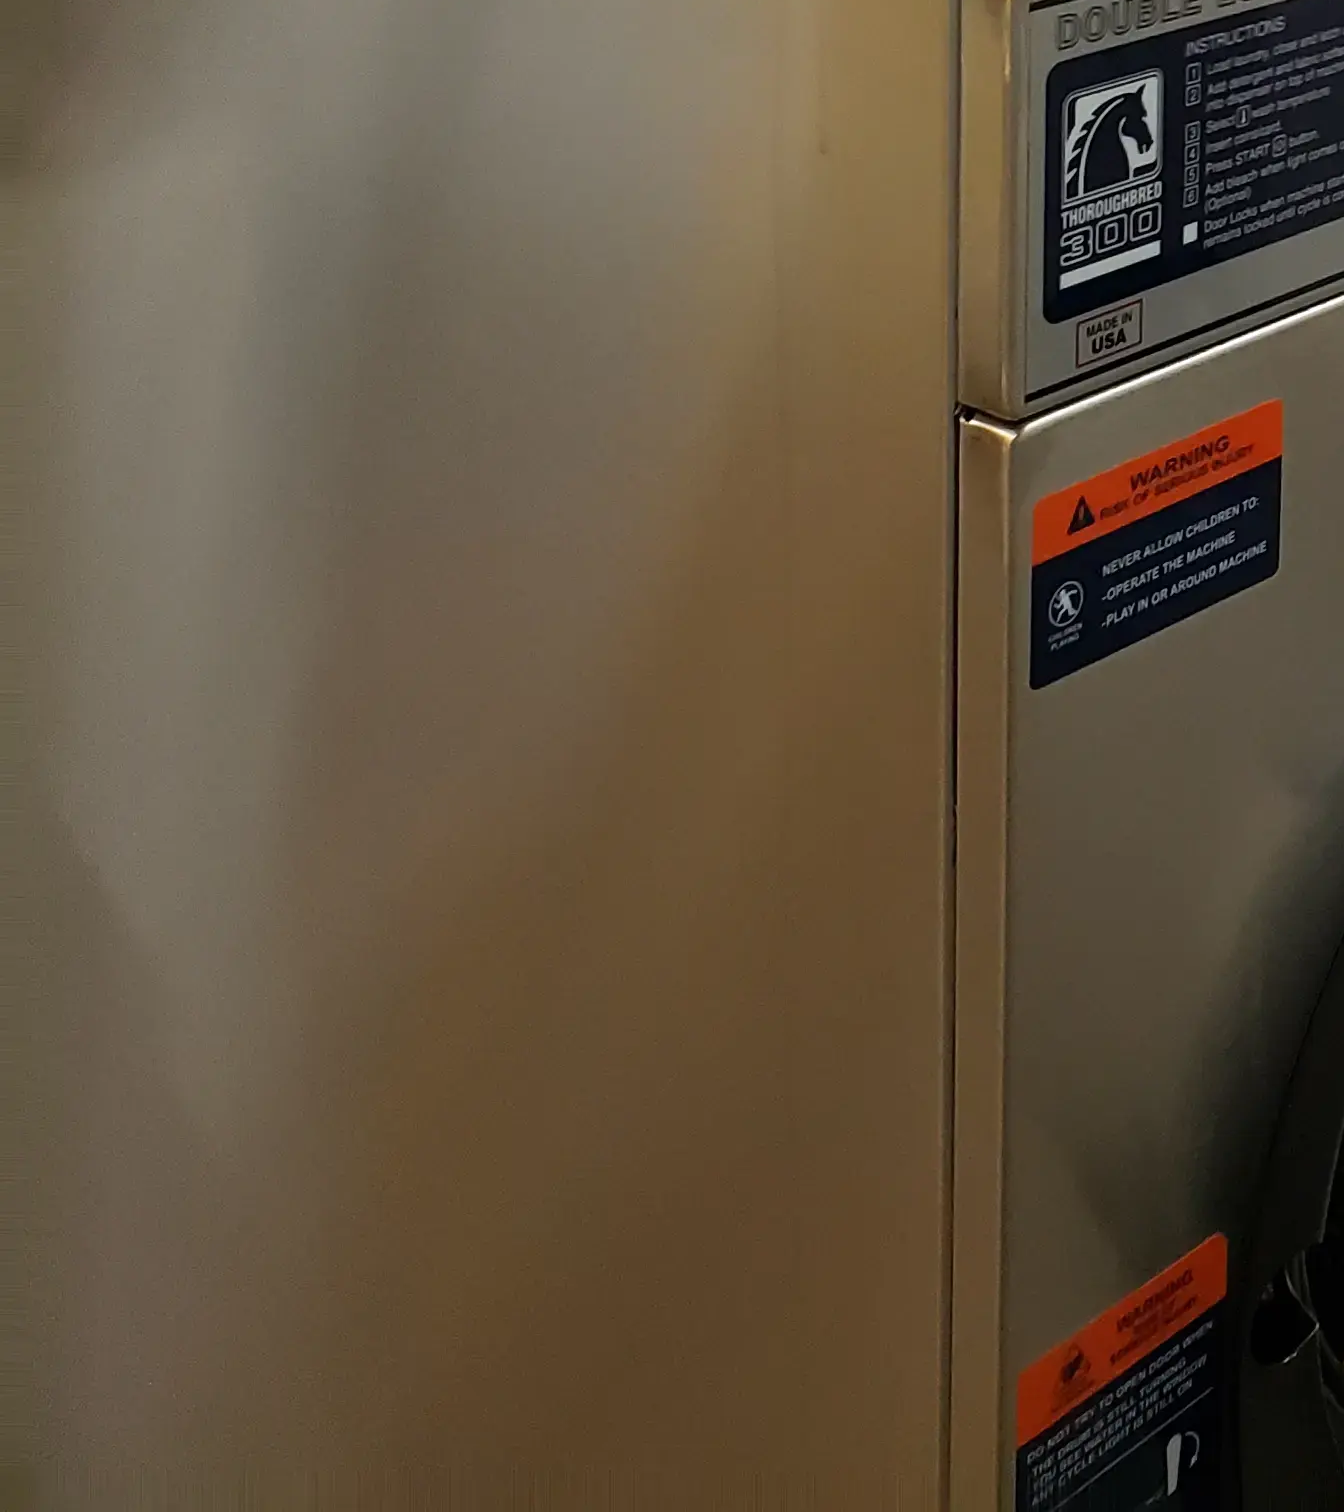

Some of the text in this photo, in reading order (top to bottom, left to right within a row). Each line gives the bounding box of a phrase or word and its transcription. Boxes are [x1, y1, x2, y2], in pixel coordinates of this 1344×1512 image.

[1185, 15, 1287, 58] INSTRUCTIONS
[1235, 143, 1271, 166] START
[1061, 181, 1163, 230] THOROUGHBRED
[1204, 216, 1228, 234] Door
[1060, 202, 1163, 267] 300
[1086, 309, 1133, 338] MADE IN
[1091, 327, 1128, 355] USA
[1129, 435, 1231, 491] WARNING
[1101, 496, 1261, 578] NEVER ALLOW CHILDREN TO:
[1101, 530, 1237, 602] -OPERATE THE MACHINE
[1101, 540, 1268, 629] -PLAY IN OR AROUND MACHINE
[1116, 1268, 1195, 1334] WARNING
[1026, 1444, 1045, 1466] DO
[1100, 1391, 1115, 1409] TO
[1115, 1367, 1147, 1402] OPEN
[1148, 1344, 1180, 1376] DOOR
[1106, 1395, 1136, 1425] STILL
[1145, 1394, 1175, 1424] STILL
